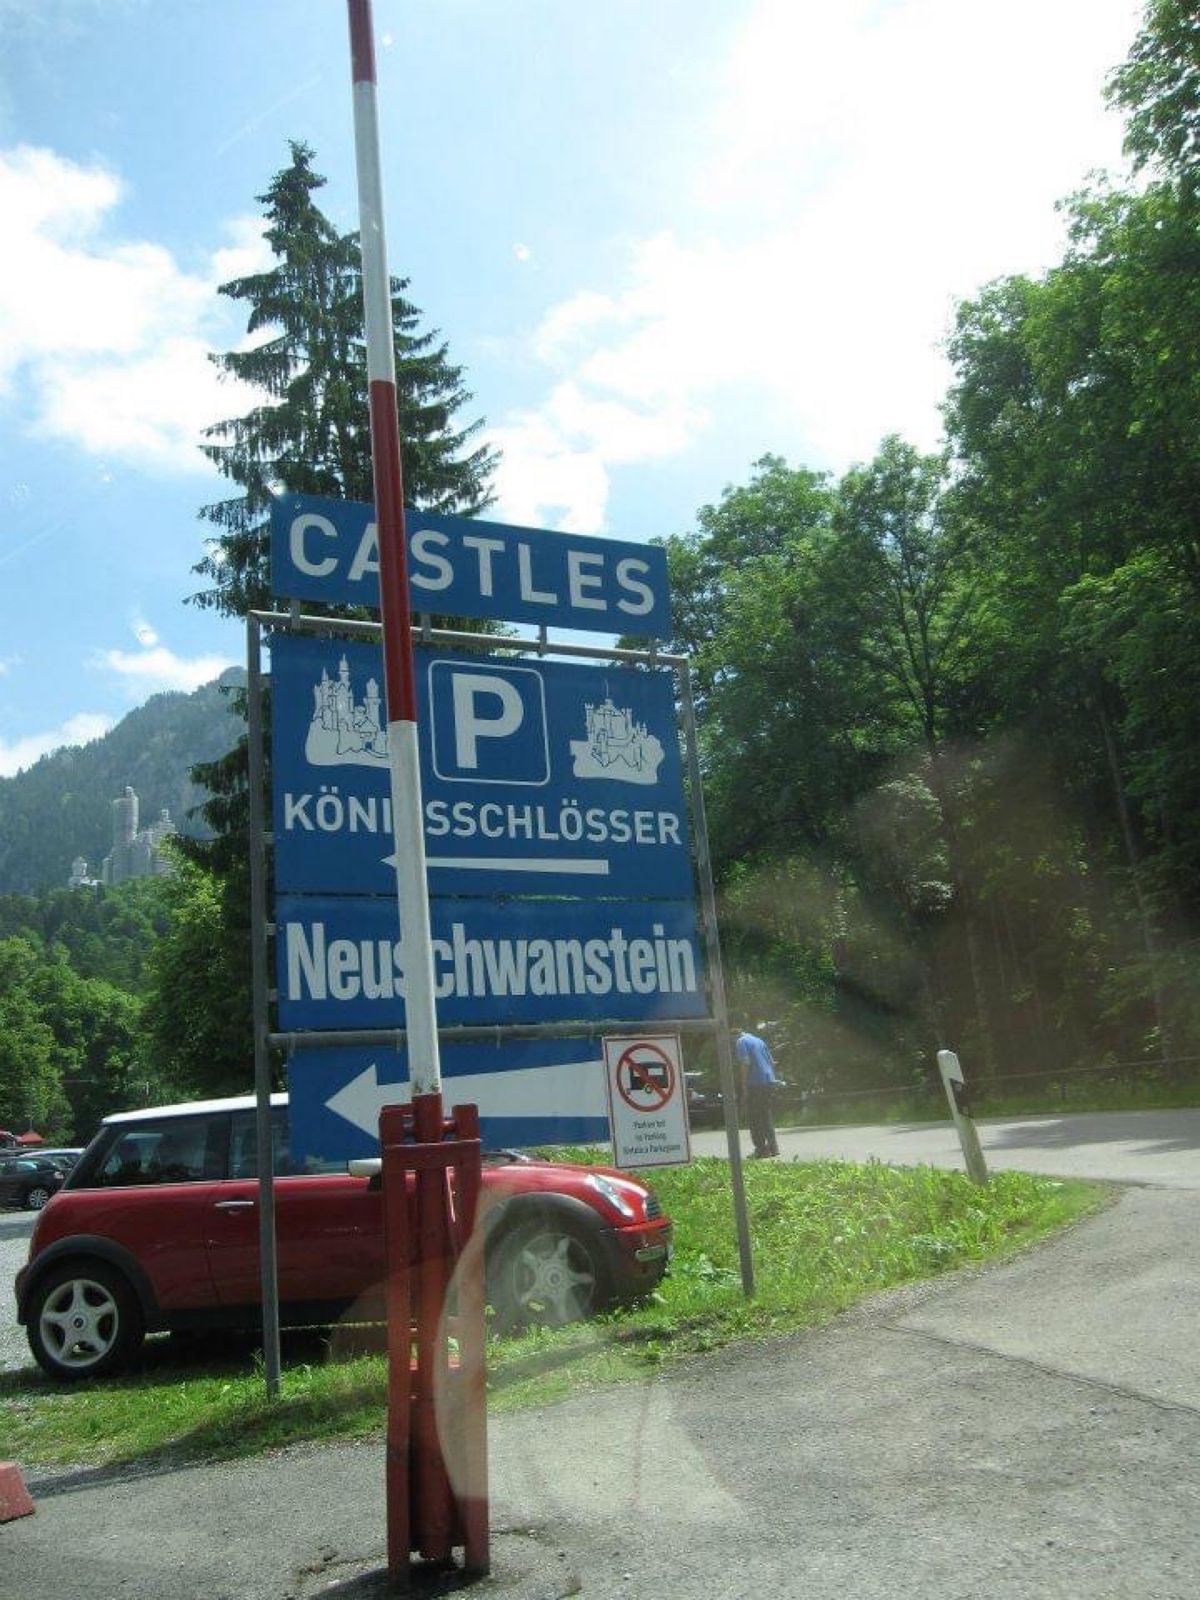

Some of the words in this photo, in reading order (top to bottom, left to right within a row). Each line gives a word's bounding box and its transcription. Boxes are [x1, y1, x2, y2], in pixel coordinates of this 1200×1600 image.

[289, 513, 655, 615] CASTLES
[452, 672, 524, 769] P
[284, 785, 682, 845] KÖNISSCHLÖSSER
